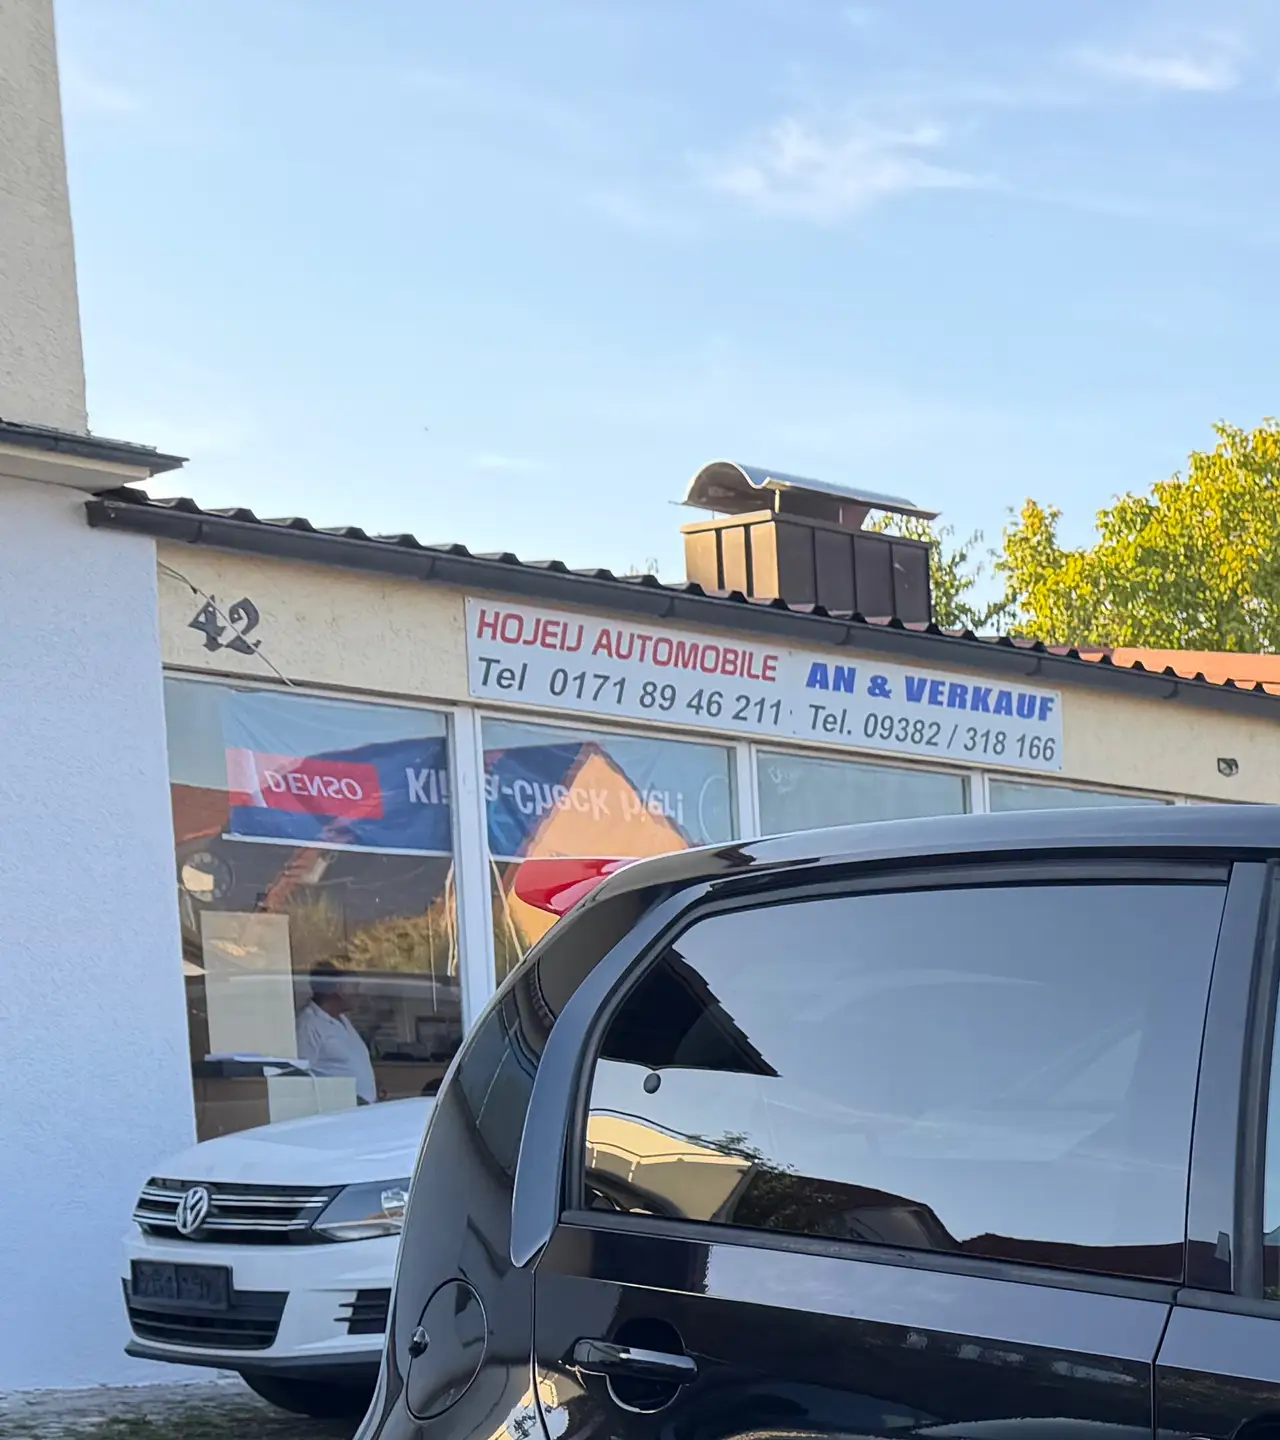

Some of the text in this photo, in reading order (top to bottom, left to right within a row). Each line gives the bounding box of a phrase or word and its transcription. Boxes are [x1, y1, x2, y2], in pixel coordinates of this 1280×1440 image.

[188, 594, 262, 656] 42
[477, 608, 1056, 722] HOJEIJ AUTOMOBILE AN & VERKAUF
[478, 657, 1056, 761] Tel 0171 89 46 211 Tel. 09382 / 318 166
